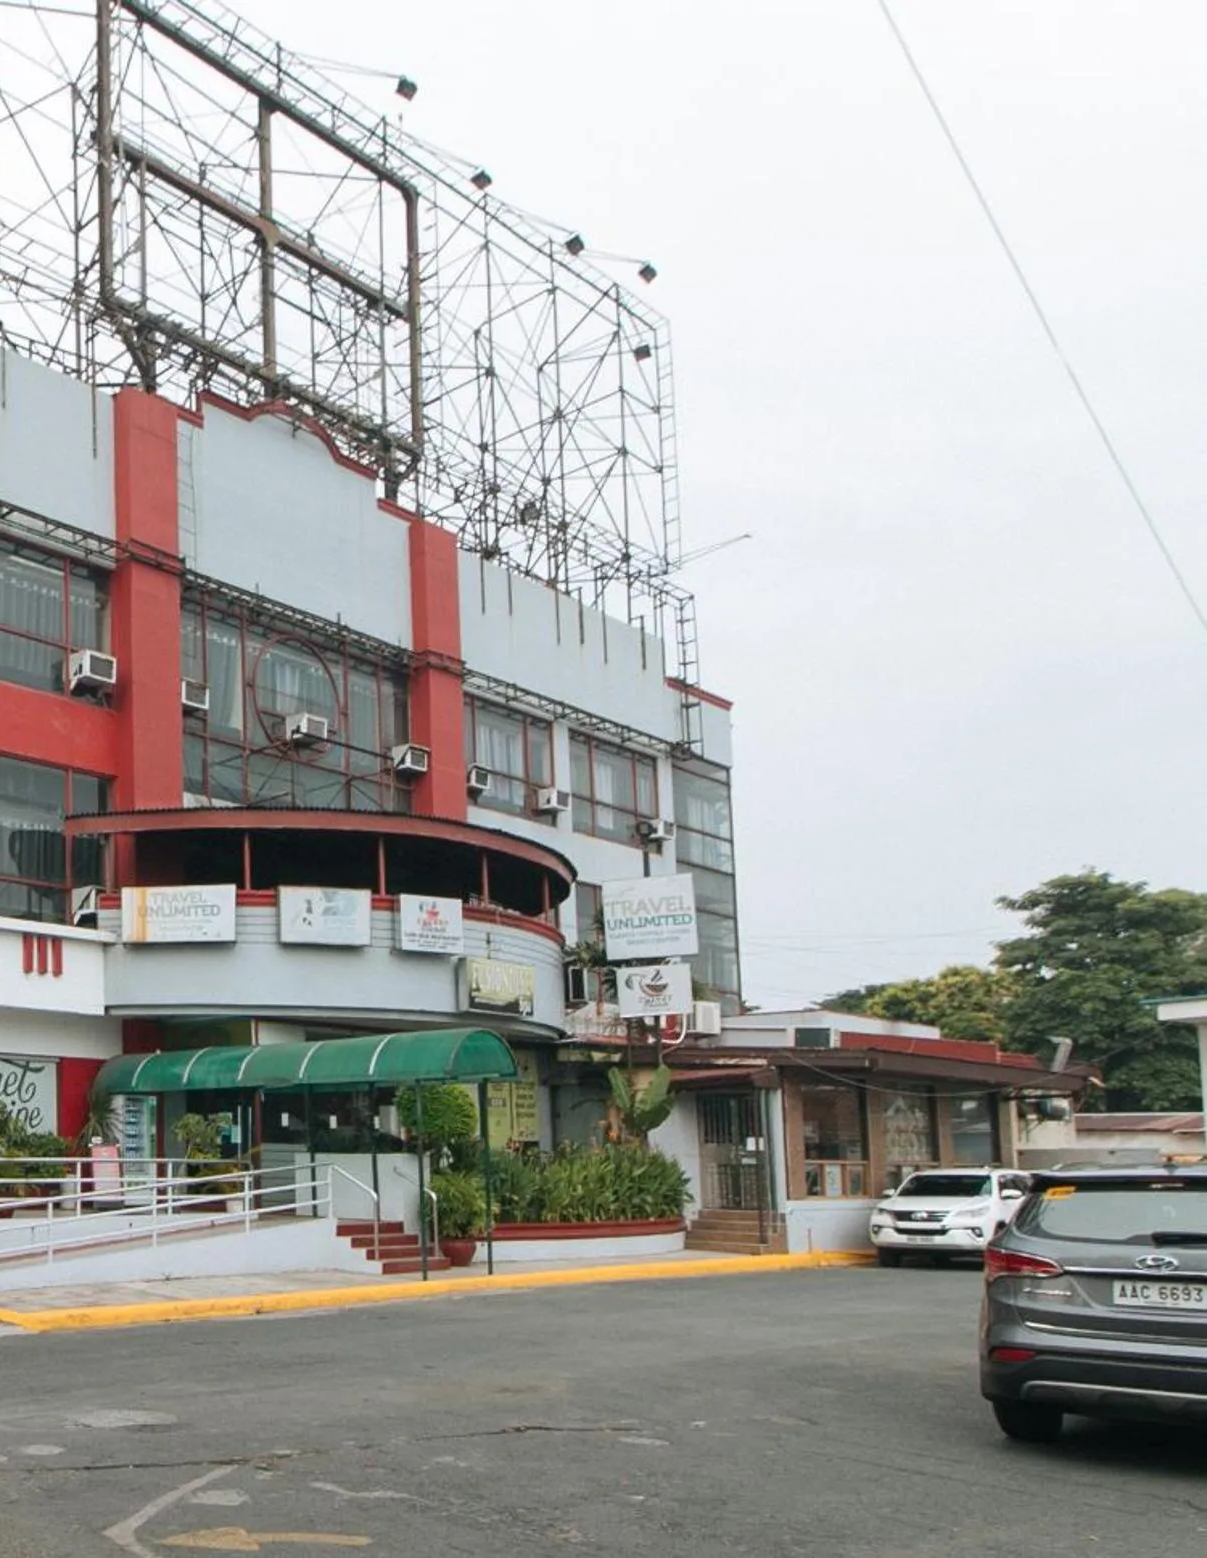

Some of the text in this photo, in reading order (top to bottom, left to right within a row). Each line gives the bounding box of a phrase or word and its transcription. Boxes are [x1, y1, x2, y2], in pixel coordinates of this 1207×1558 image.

[149, 891, 208, 904] TRAVEL
[605, 894, 692, 917] TRAVEL
[137, 903, 222, 918] UNLIMITED
[606, 913, 694, 932] UNLIMITED
[1119, 1283, 1204, 1303] AAC 6693
